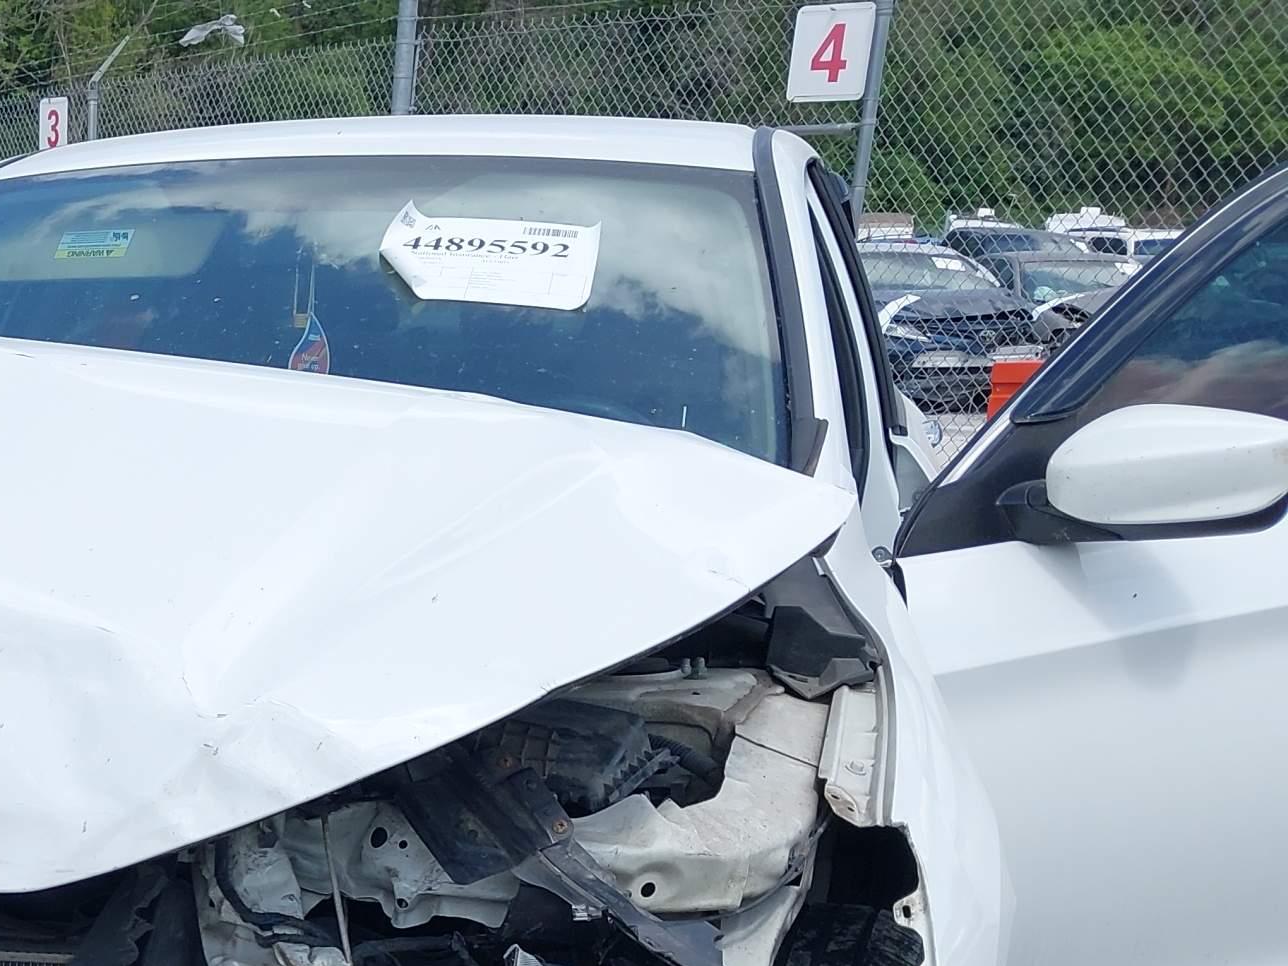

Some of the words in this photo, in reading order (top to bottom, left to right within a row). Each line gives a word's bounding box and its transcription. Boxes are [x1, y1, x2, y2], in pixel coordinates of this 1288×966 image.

[810, 23, 847, 83] 4
[47, 109, 59, 148] 3
[402, 236, 570, 258] 44895592
